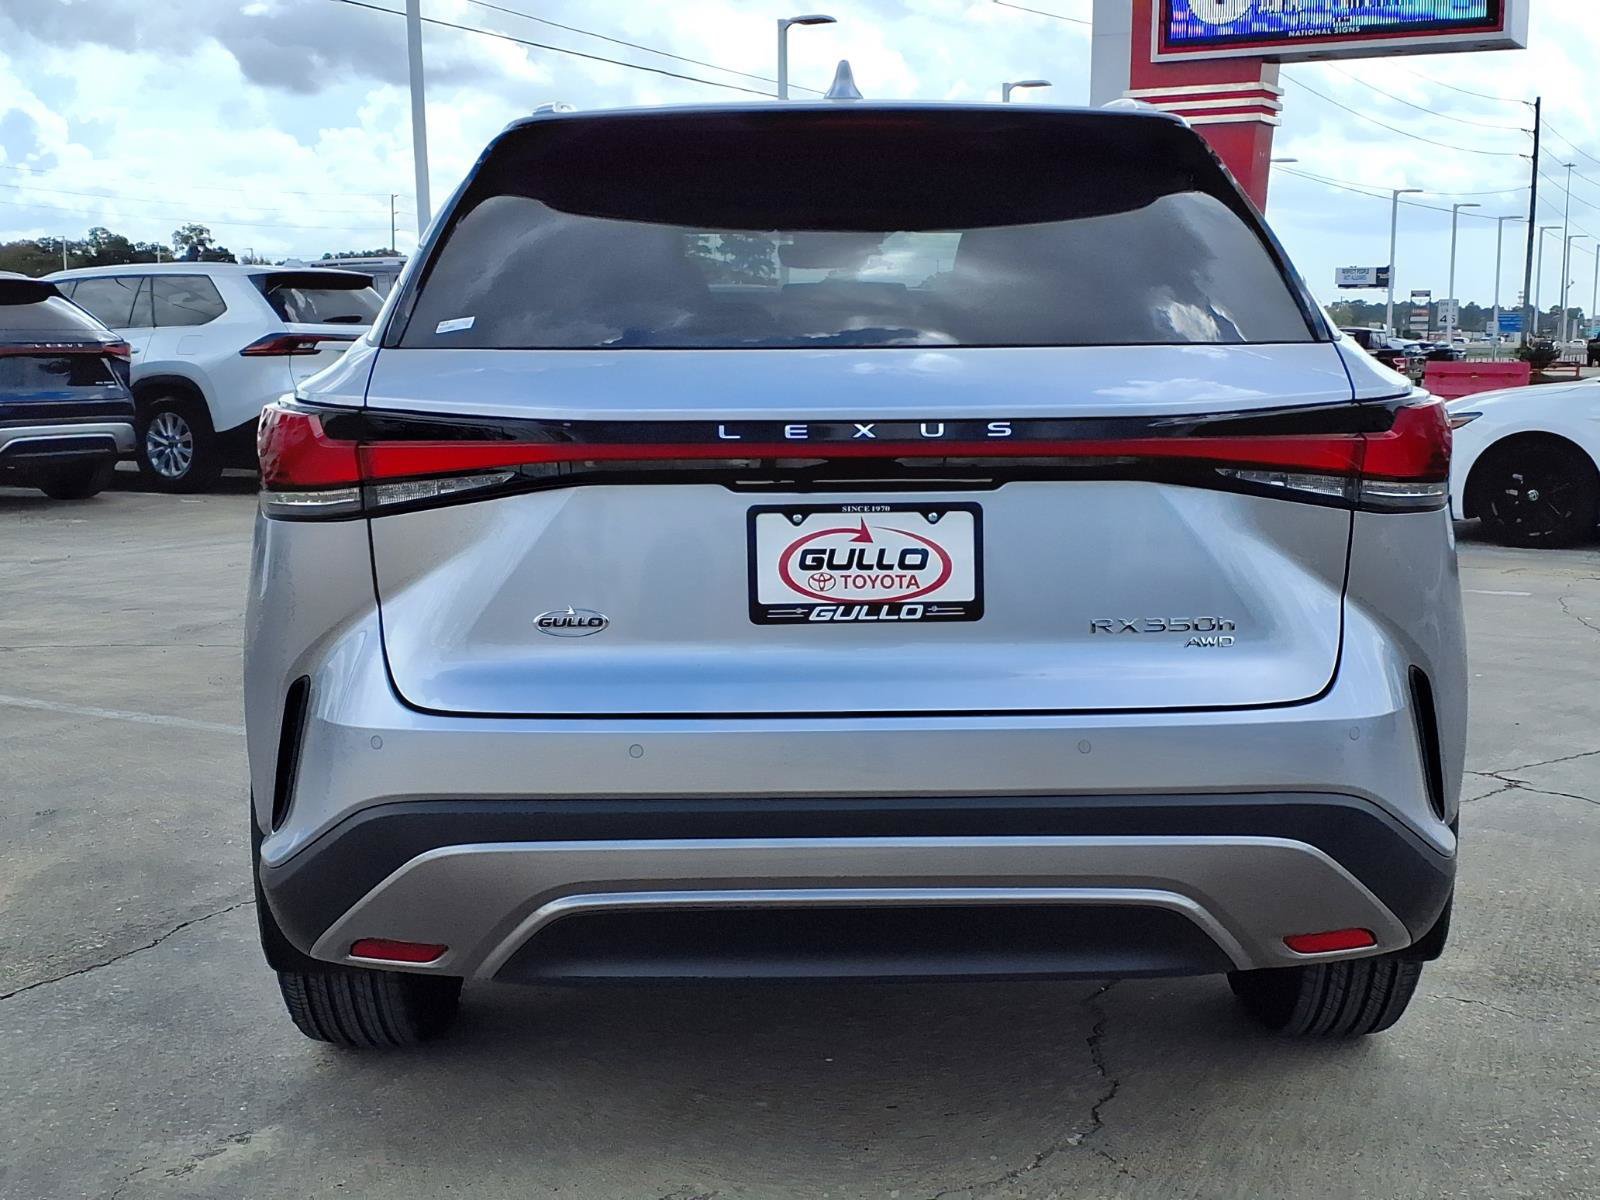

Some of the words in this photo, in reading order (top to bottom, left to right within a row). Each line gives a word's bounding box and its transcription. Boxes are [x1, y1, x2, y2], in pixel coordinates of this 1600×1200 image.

[1288, 28, 1332, 37] NATIONAL
[1333, 26, 1361, 34] SIGNS
[718, 421, 1012, 439] LEXUS
[798, 548, 930, 571] GULLO
[840, 574, 921, 590] TOYOTA
[808, 604, 924, 621] GULLO
[538, 617, 604, 628] GULLO
[1183, 636, 1236, 649] AWD
